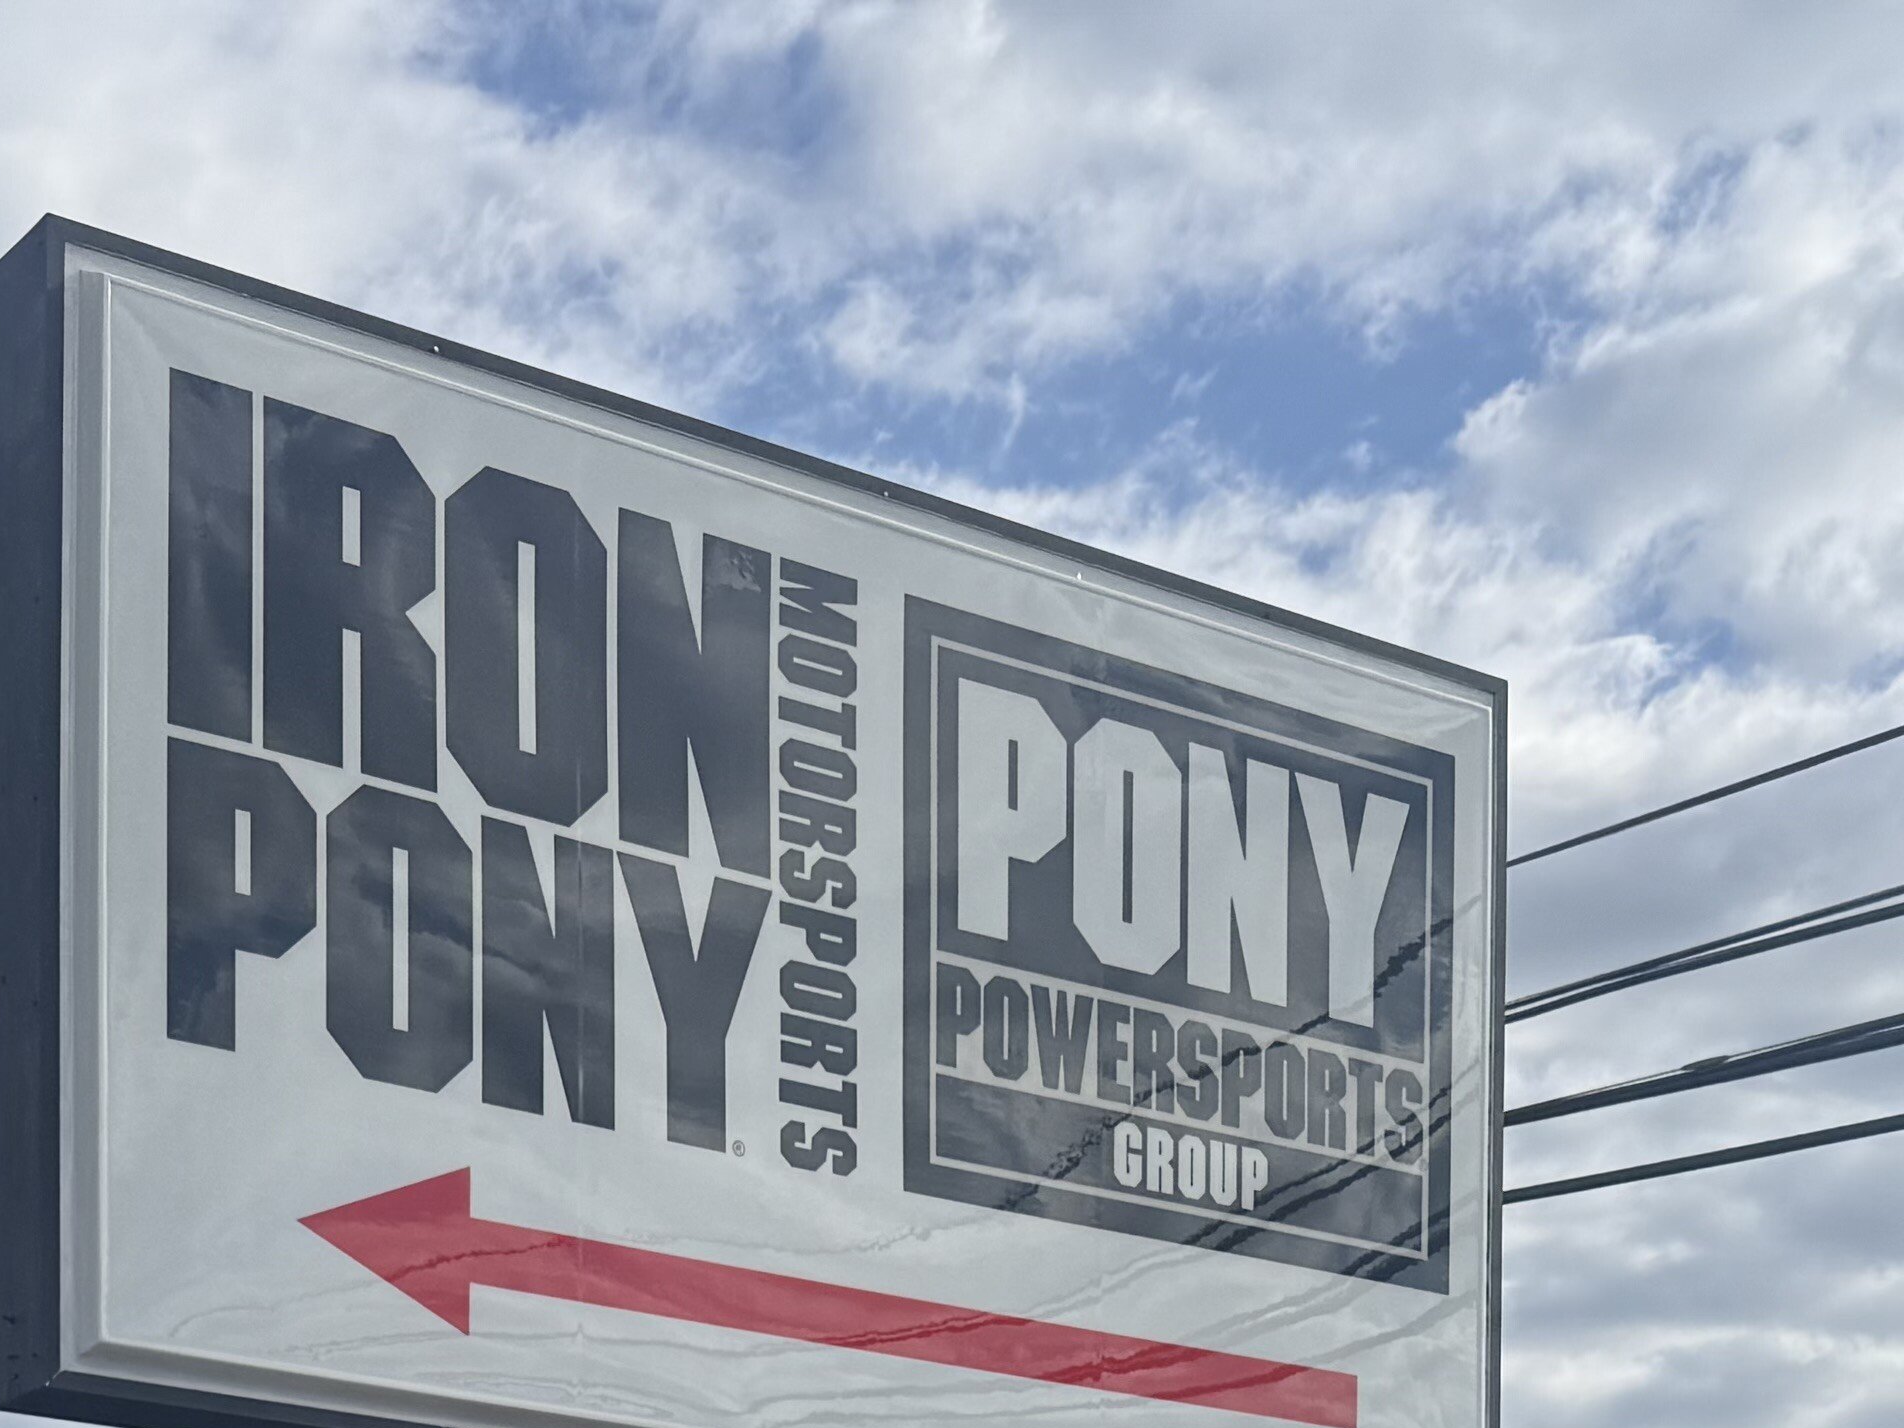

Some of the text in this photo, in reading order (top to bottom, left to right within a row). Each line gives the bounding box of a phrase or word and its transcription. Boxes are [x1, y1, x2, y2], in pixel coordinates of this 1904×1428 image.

[167, 367, 773, 878] IRON
[167, 735, 773, 1154] PONY
[778, 557, 858, 1177] MOTORSPORTS
[958, 677, 1410, 1029] PONY
[936, 961, 1423, 1163] POWERSPORTS
[1113, 1122, 1269, 1211] GROUP
